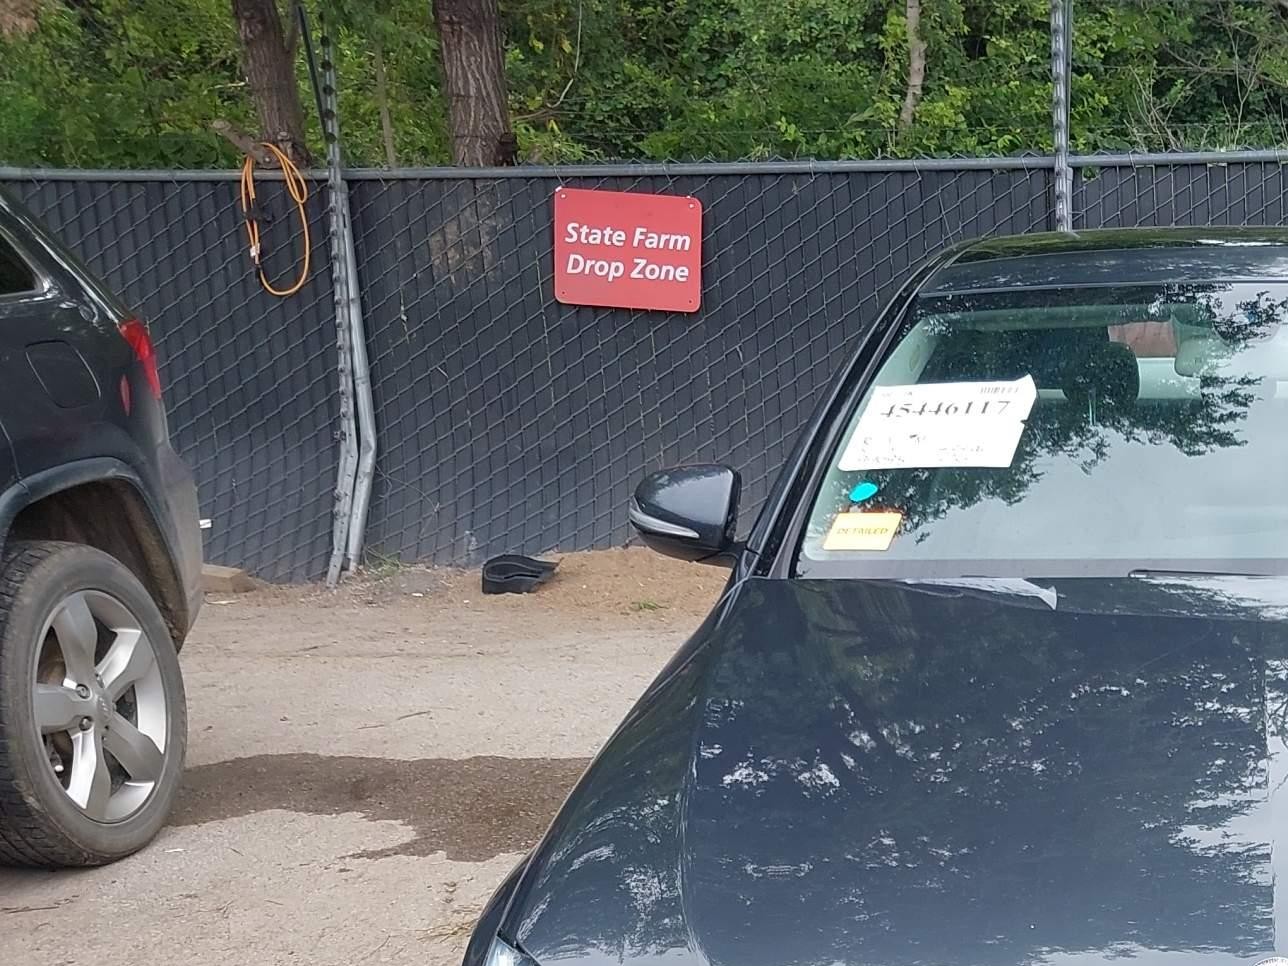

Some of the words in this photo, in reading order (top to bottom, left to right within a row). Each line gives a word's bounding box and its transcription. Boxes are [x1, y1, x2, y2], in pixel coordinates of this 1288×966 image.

[564, 223, 626, 247] State
[632, 227, 692, 251] Farm
[566, 254, 625, 282] Drop
[630, 258, 690, 282] Zone
[880, 400, 1011, 418] 45446117
